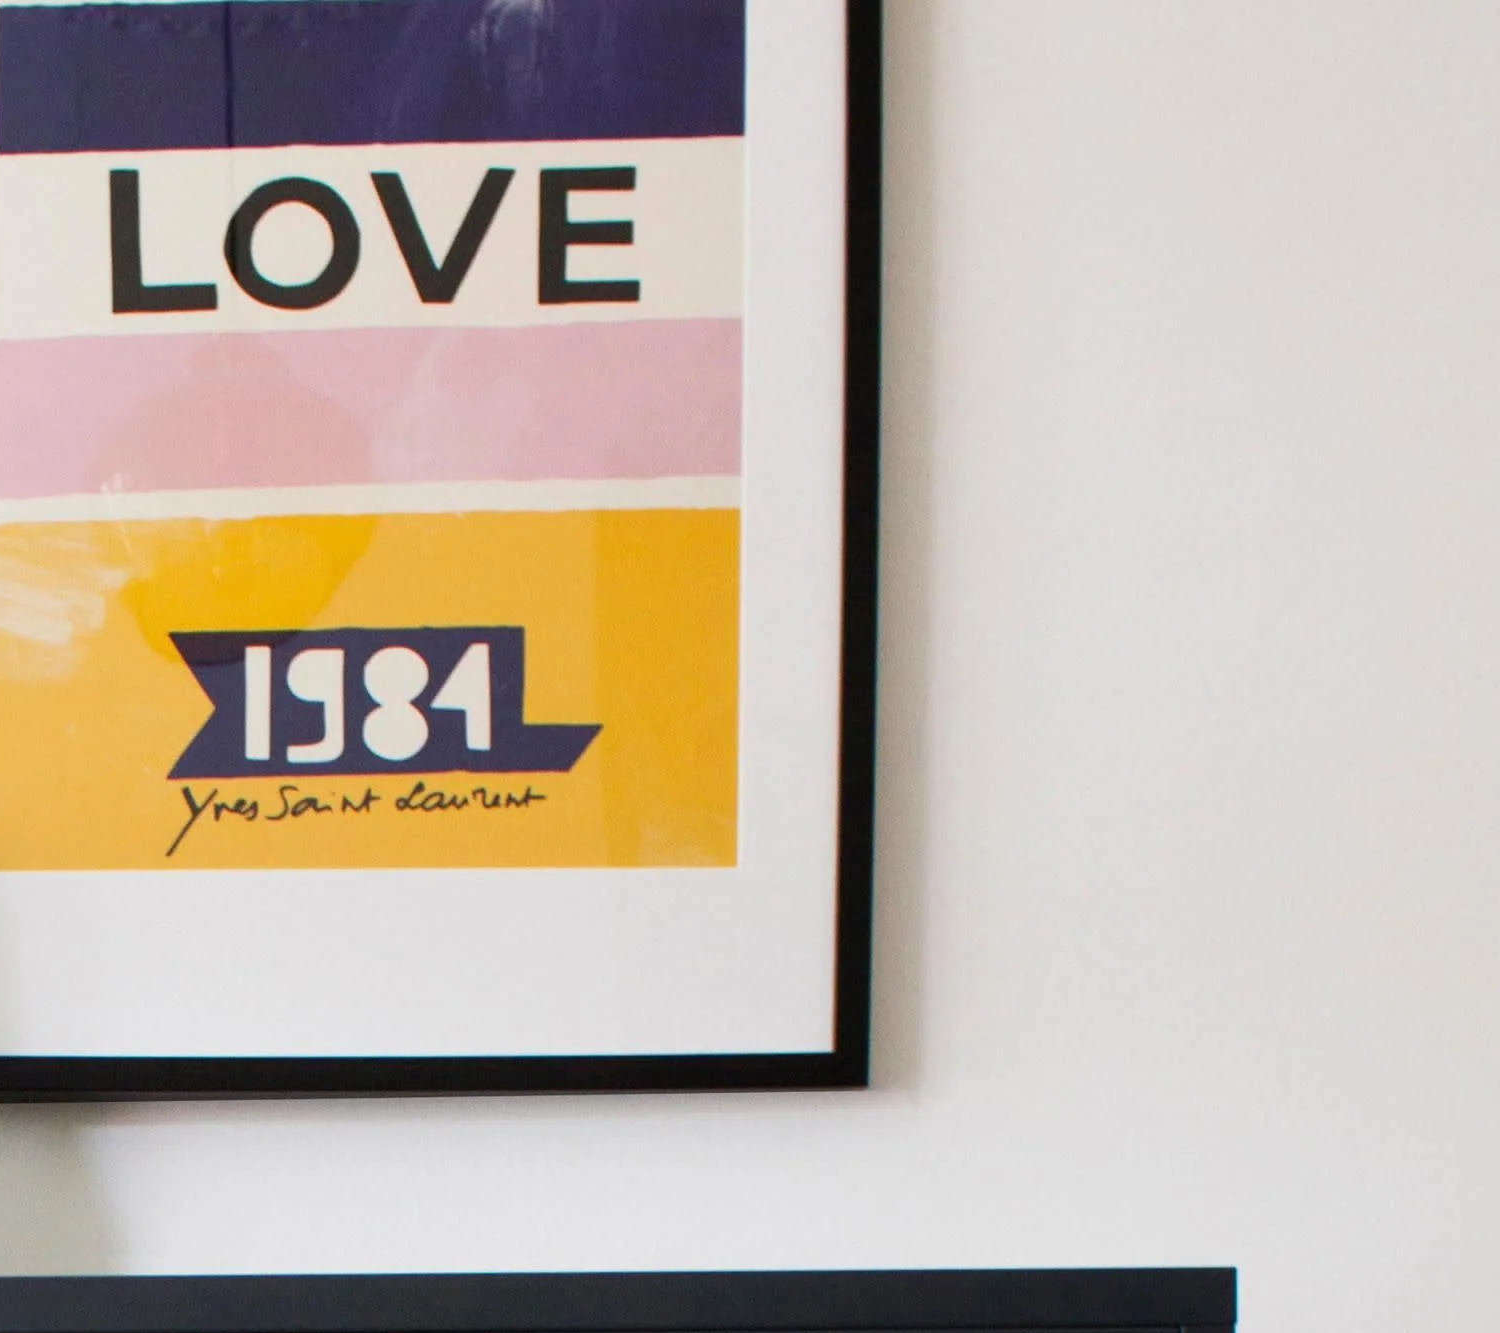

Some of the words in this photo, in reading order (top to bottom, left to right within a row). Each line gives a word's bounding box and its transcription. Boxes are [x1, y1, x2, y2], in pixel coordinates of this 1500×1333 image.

[108, 166, 641, 314] LOVE
[244, 642, 491, 764] 1984
[165, 786, 258, 858] Yves
[265, 784, 380, 822] Saint
[395, 781, 547, 812] Laurent
